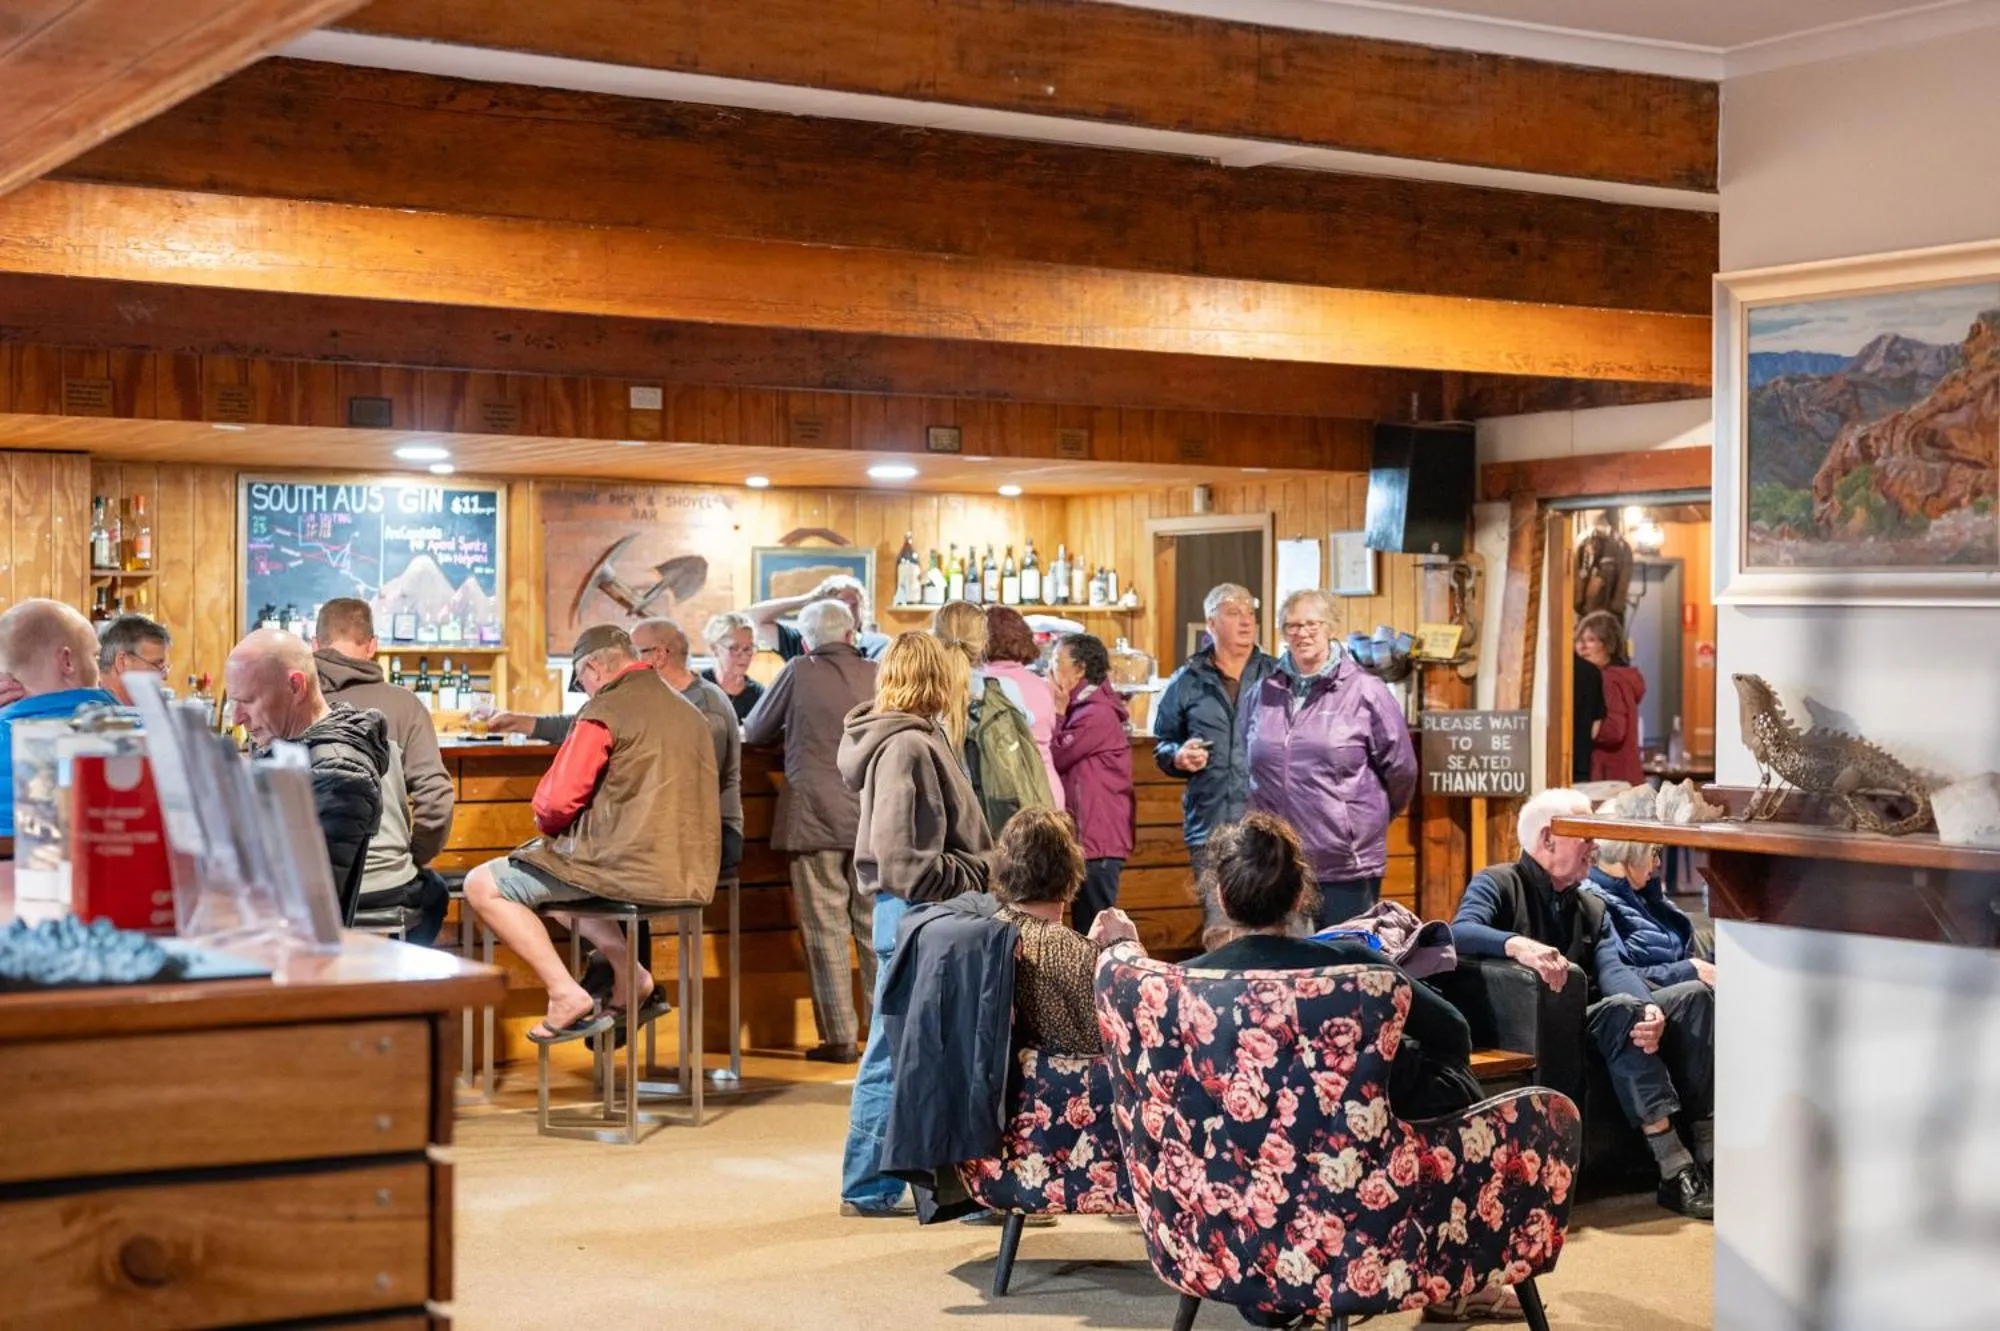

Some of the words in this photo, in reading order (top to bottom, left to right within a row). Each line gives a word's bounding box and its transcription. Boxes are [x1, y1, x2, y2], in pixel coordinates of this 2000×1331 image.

[251, 484, 327, 514] SOUTH
[333, 484, 385, 514] AUS
[398, 486, 444, 514] GIN
[1424, 715, 1483, 731] PLEASE
[1488, 715, 1529, 731] WAIT
[1448, 735, 1473, 751] TO
[1490, 734, 1512, 751] BE
[1447, 754, 1512, 771] SEATED
